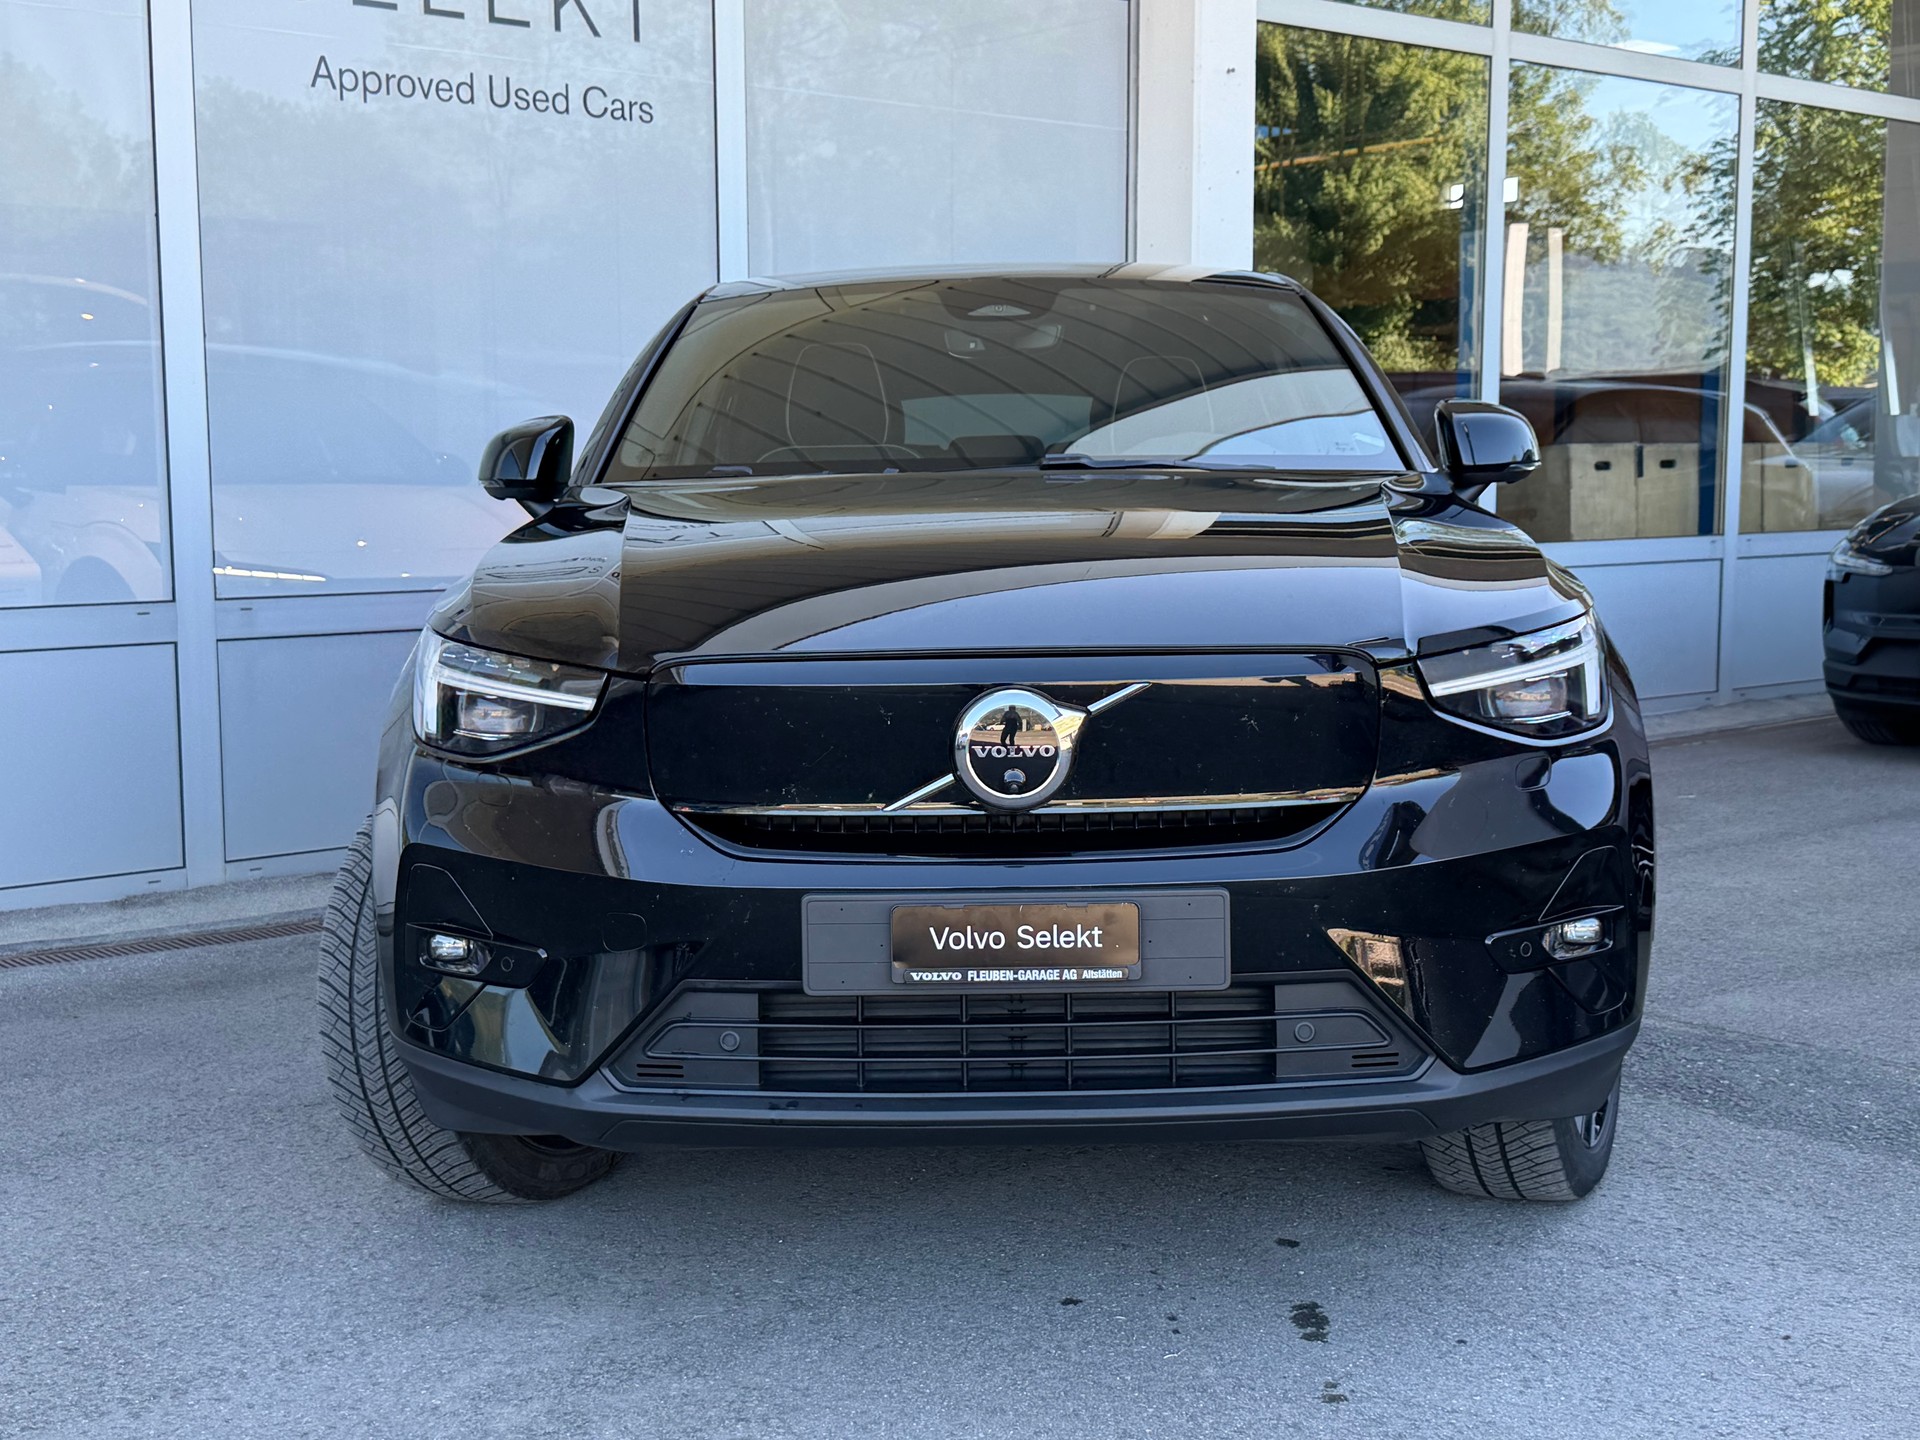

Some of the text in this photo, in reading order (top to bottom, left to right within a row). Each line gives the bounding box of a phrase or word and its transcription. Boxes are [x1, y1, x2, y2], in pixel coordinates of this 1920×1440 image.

[310, 55, 655, 124] Approved Used Cars
[971, 745, 1055, 758] VOLVO
[929, 924, 1103, 950] Volvo Selekt
[910, 969, 1123, 982] VOLVO FLEUBEN-GARAGE AG Altstätten
